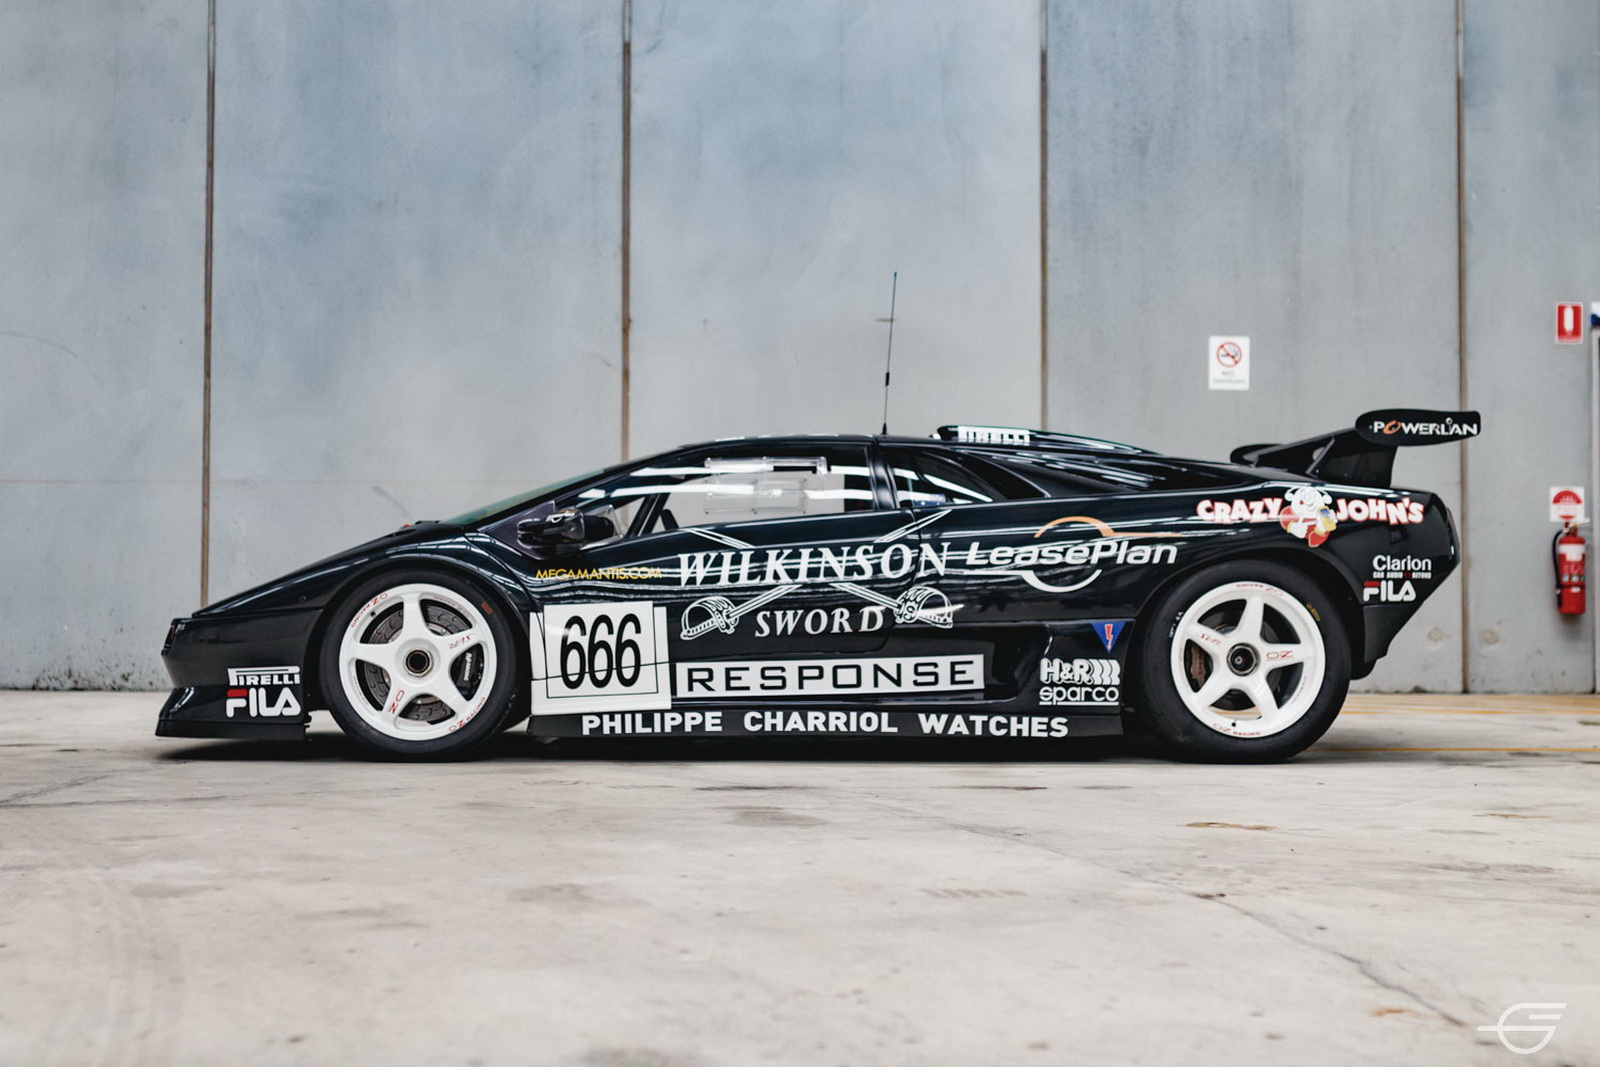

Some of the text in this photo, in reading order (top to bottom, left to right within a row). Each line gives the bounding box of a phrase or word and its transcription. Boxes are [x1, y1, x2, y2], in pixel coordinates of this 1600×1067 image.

[1373, 417, 1478, 436] POWERLAN
[1196, 497, 1425, 526] CRAZY JOHN'S
[677, 542, 952, 588] WILKINSON
[965, 541, 1178, 565] LeasePlan
[1372, 554, 1432, 571] Clarion
[535, 566, 663, 581] MEGAMANTIS.COM
[1362, 579, 1417, 602] FILA
[754, 605, 885, 638] SWORD
[559, 612, 642, 690] 666
[227, 665, 301, 686] PIRELLI
[686, 659, 975, 693] RESPONSE
[226, 686, 301, 718] FILA
[1040, 686, 1120, 705] sparco
[581, 710, 1070, 738] PHILIPPE CHARRIOL WATCHES
